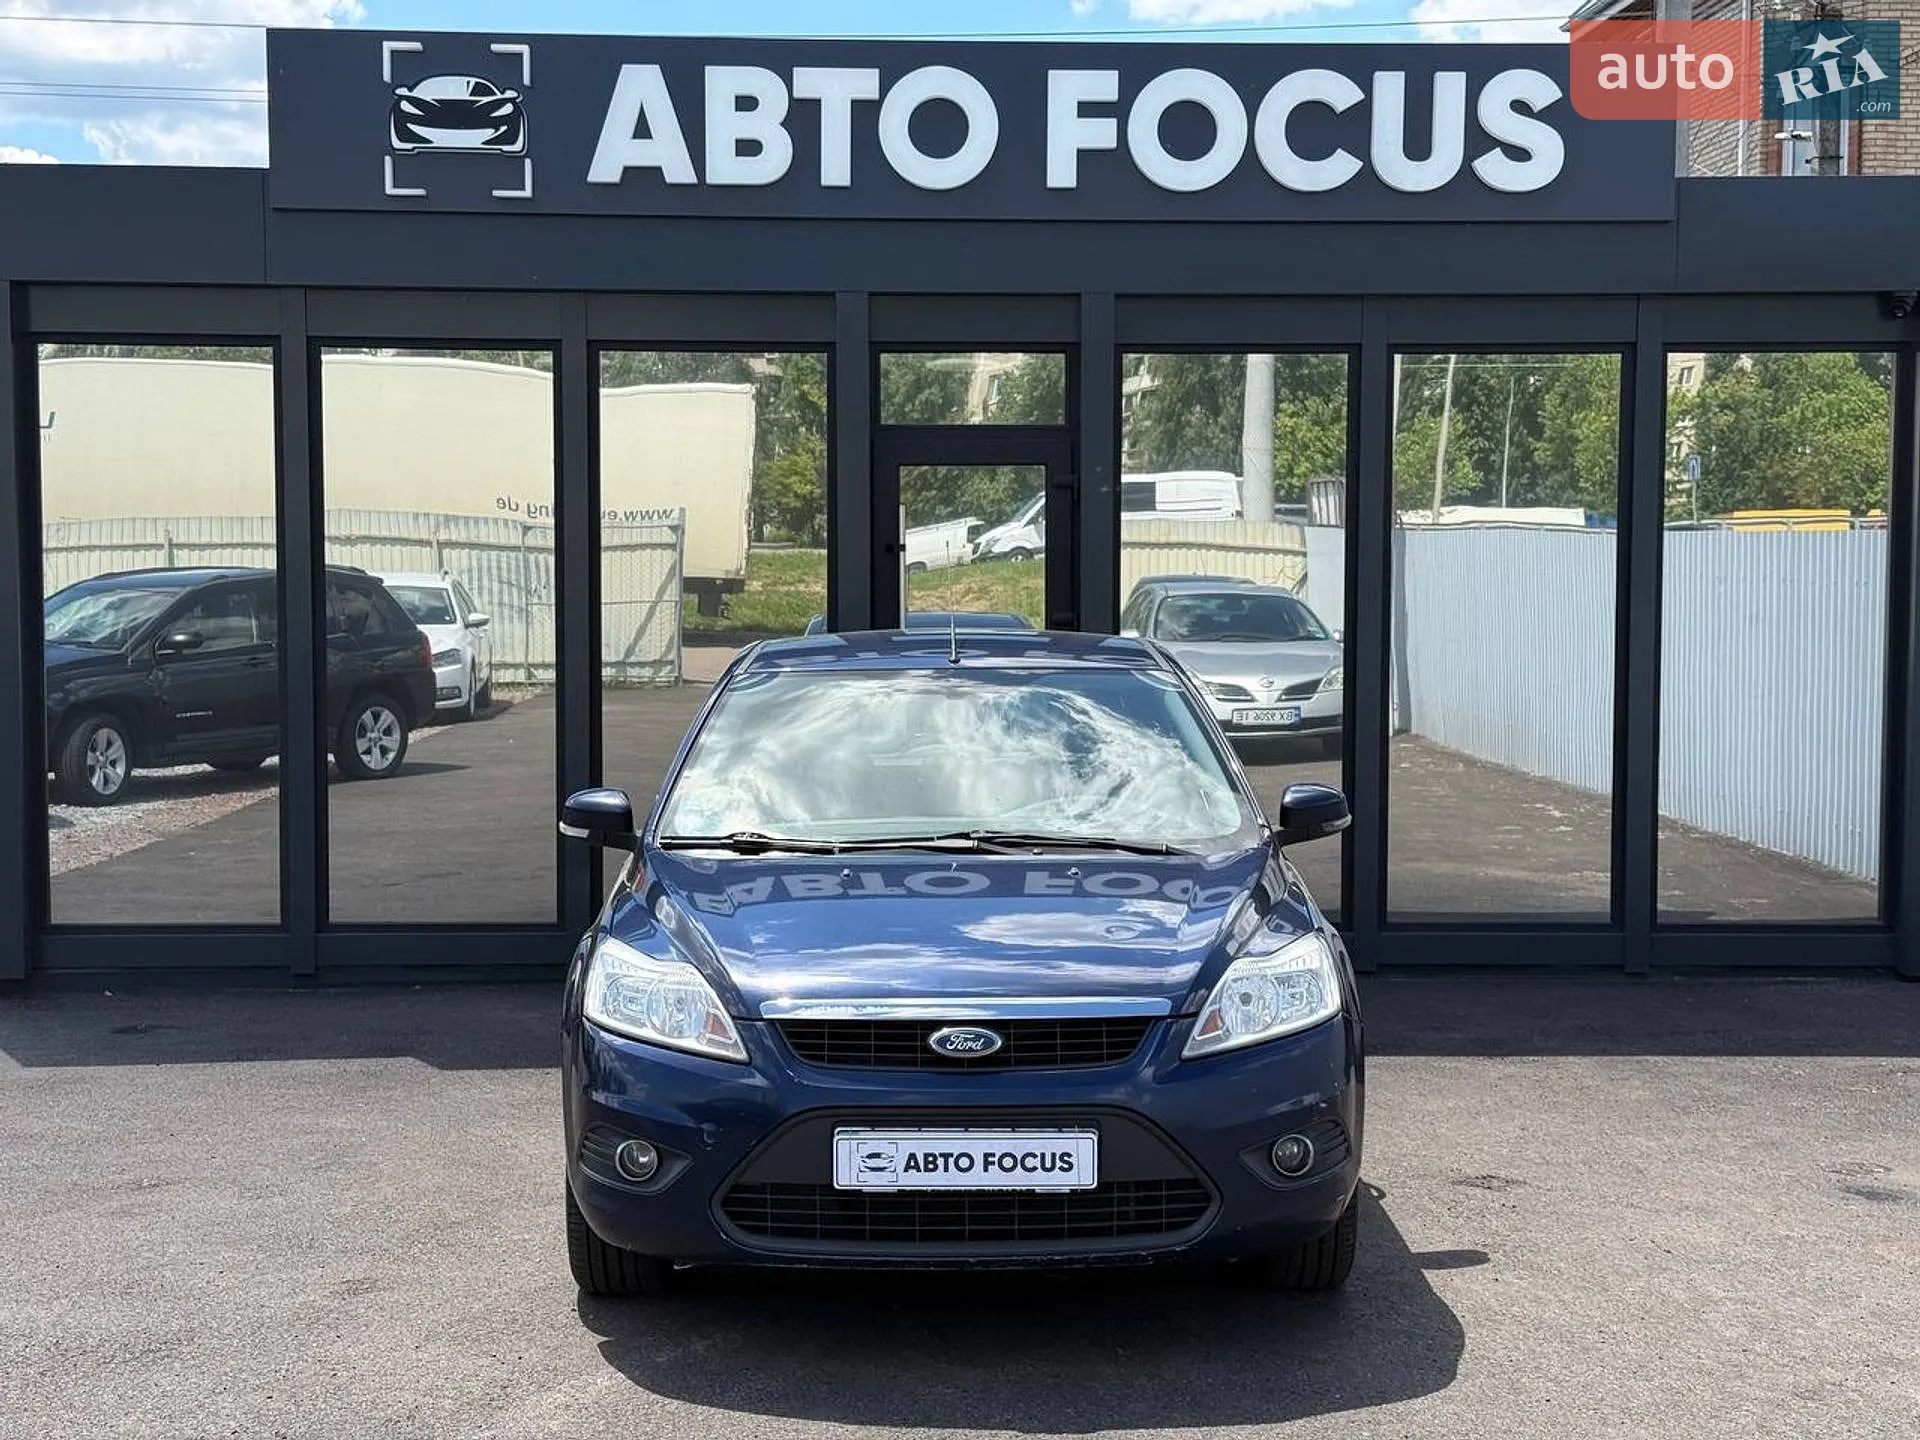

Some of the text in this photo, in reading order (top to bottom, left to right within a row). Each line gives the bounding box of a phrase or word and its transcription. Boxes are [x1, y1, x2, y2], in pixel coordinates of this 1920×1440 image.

[587, 63, 1565, 194] АВТО FOCUS
[946, 1033, 985, 1051] Ford
[903, 1151, 1075, 1174] АВТО FOCUS
